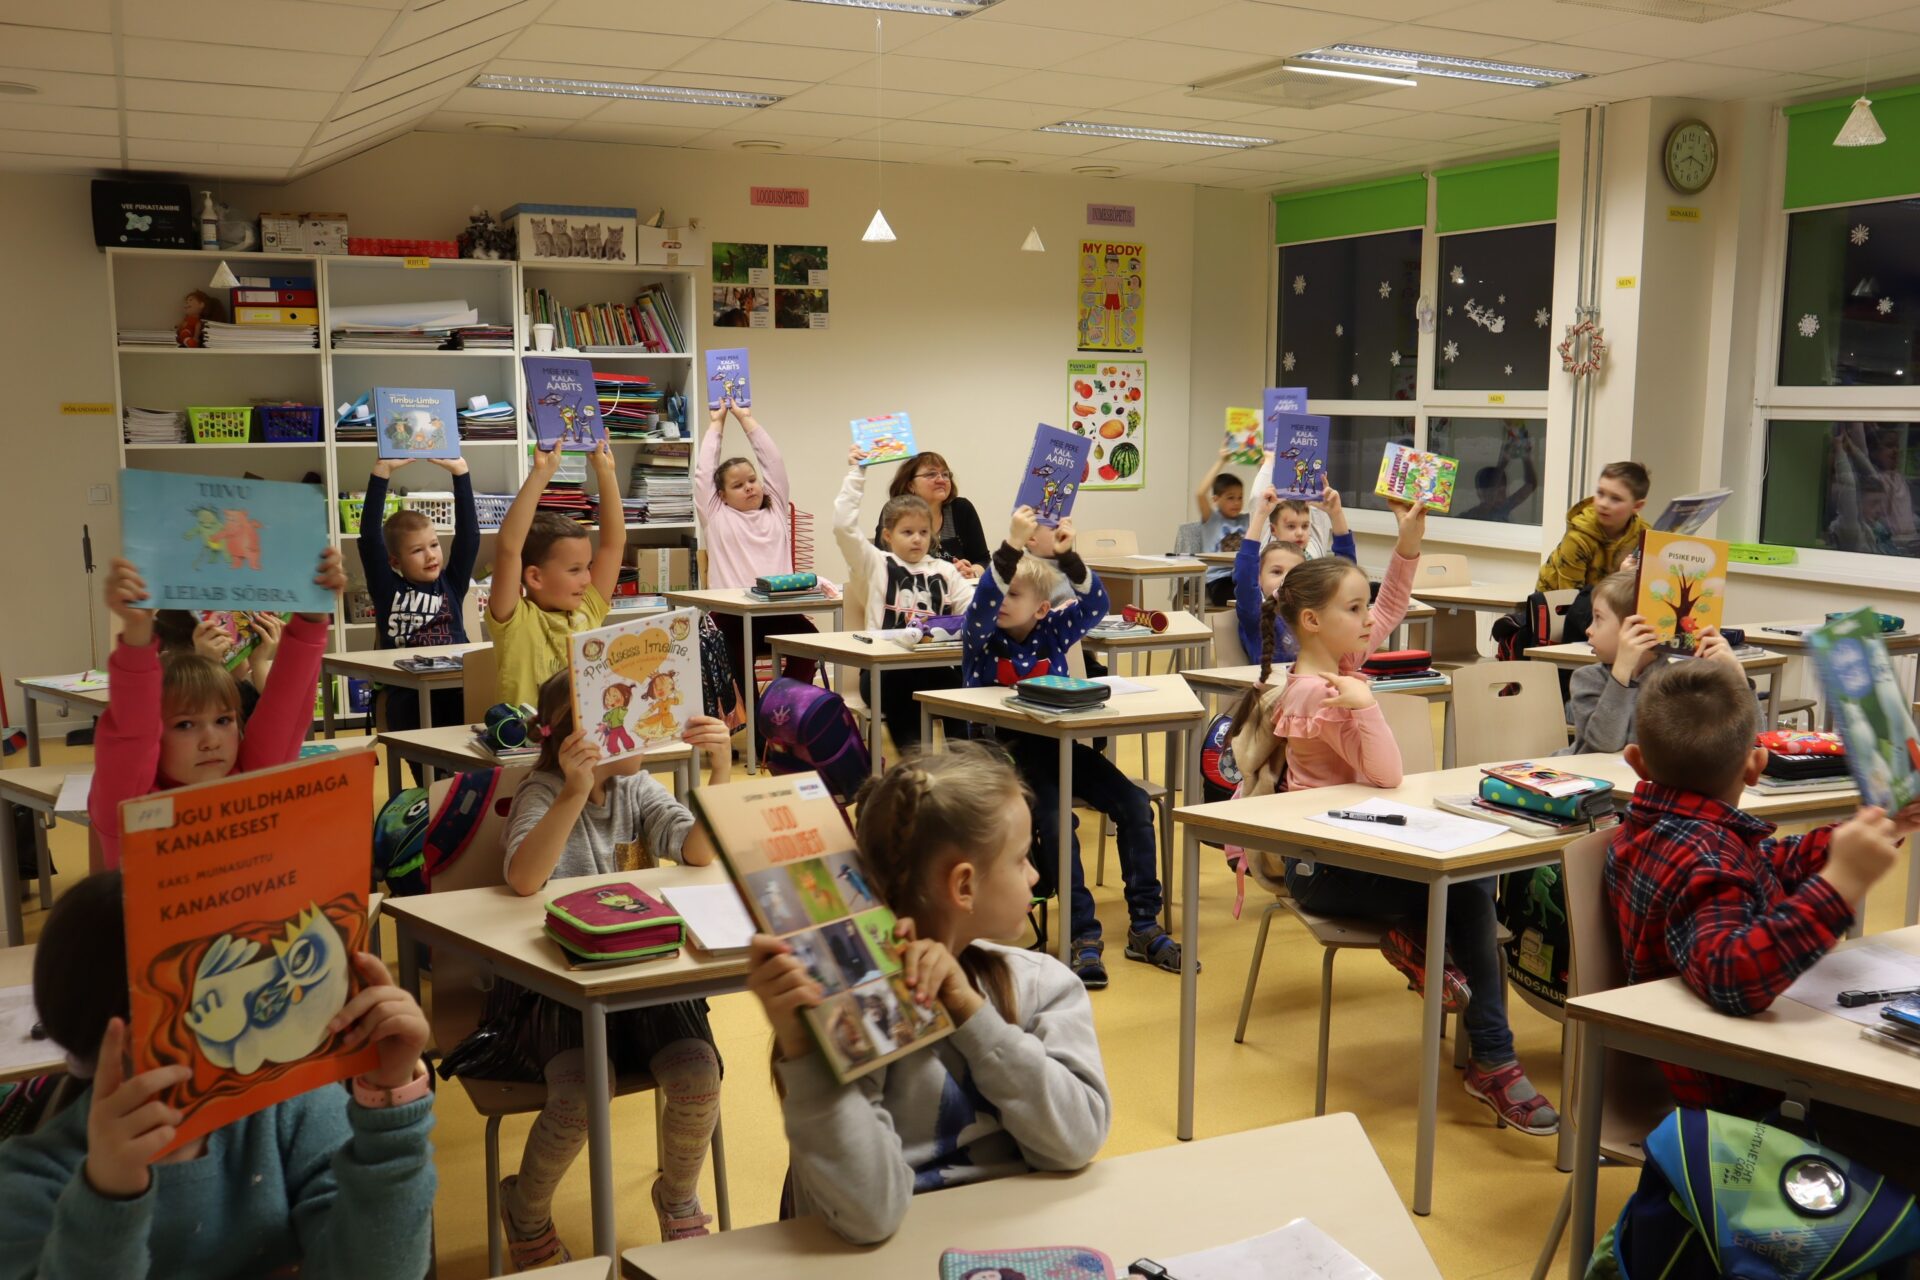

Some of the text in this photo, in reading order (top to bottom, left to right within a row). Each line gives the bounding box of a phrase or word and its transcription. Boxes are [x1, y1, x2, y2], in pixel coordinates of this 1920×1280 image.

[756, 188, 805, 205] LOODUSÕPETUS
[1083, 243, 1142, 257] MY BODY
[546, 382, 583, 392] AABITS
[390, 396, 440, 405] Timbu-Limbu
[1049, 438, 1079, 453] MEIE PERE
[1290, 438, 1319, 447] AABITS
[1053, 447, 1072, 458] KALA-
[1045, 453, 1075, 469] AABITS
[1668, 552, 1706, 564] PISIKE PUU
[163, 584, 299, 602] LEIAB SÕBRA
[583, 645, 641, 681] Printsess
[644, 639, 689, 658] Imeline
[157, 806, 213, 831] UGU
[220, 774, 349, 818] KULDHARJAGA
[156, 813, 280, 856] KANAKESEST
[157, 876, 191, 890] KAKS
[159, 870, 297, 922] KANAKOIVAKE
[1731, 1157, 1746, 1184] CORE
